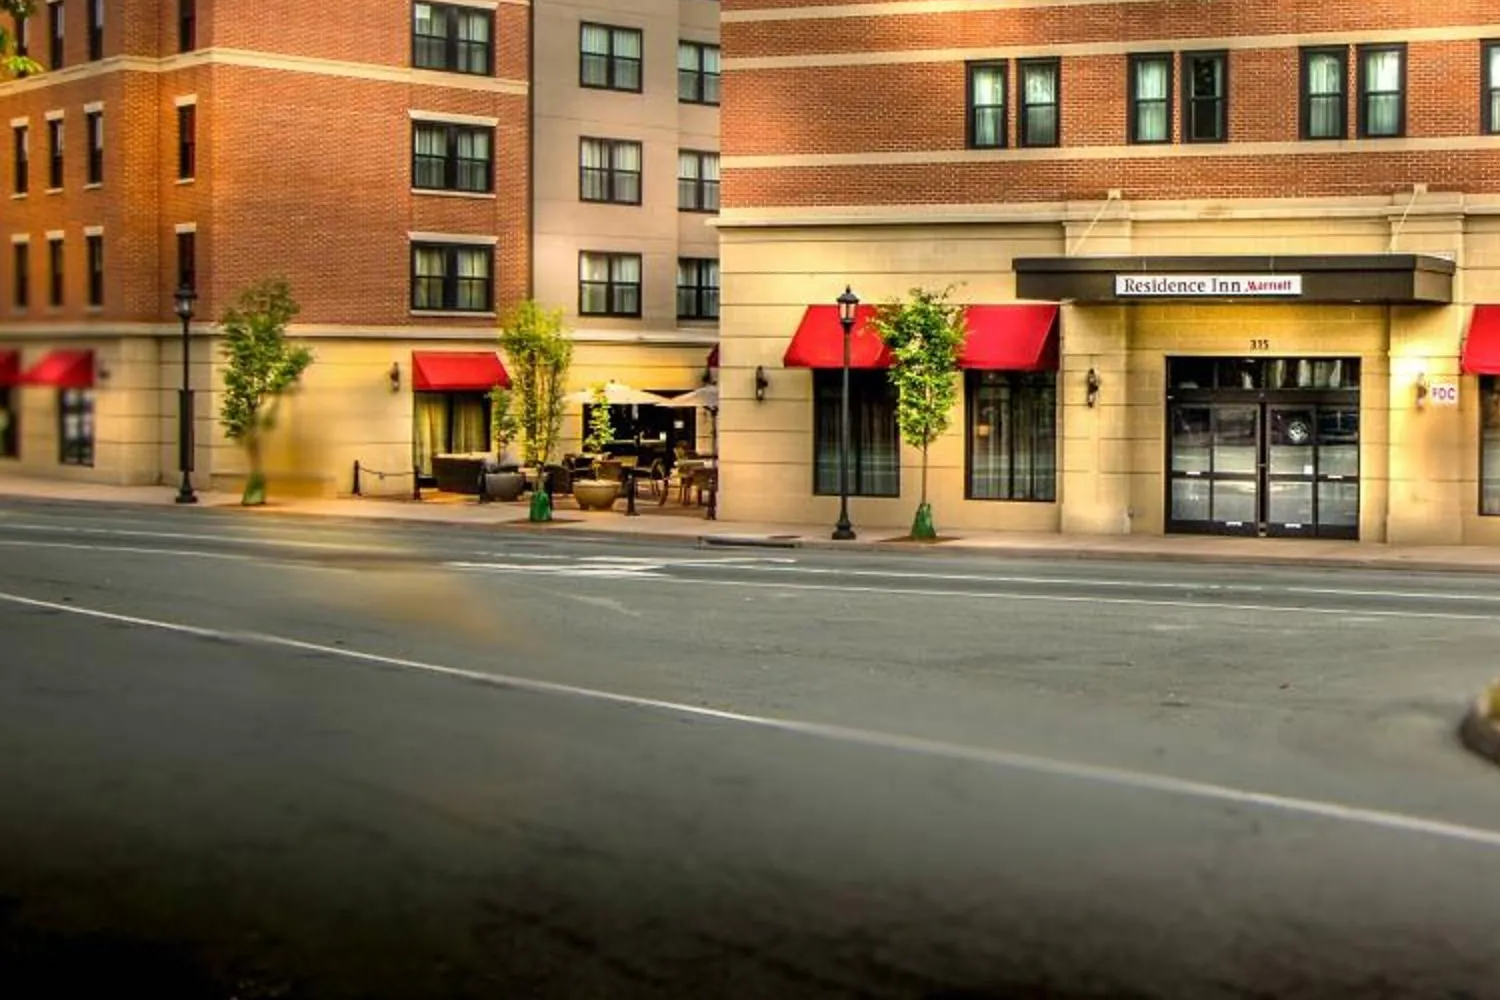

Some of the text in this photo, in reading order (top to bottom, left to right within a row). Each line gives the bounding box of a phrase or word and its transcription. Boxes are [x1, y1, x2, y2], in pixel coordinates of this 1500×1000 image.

[1124, 278, 1292, 293] Residence Inn Marriott
